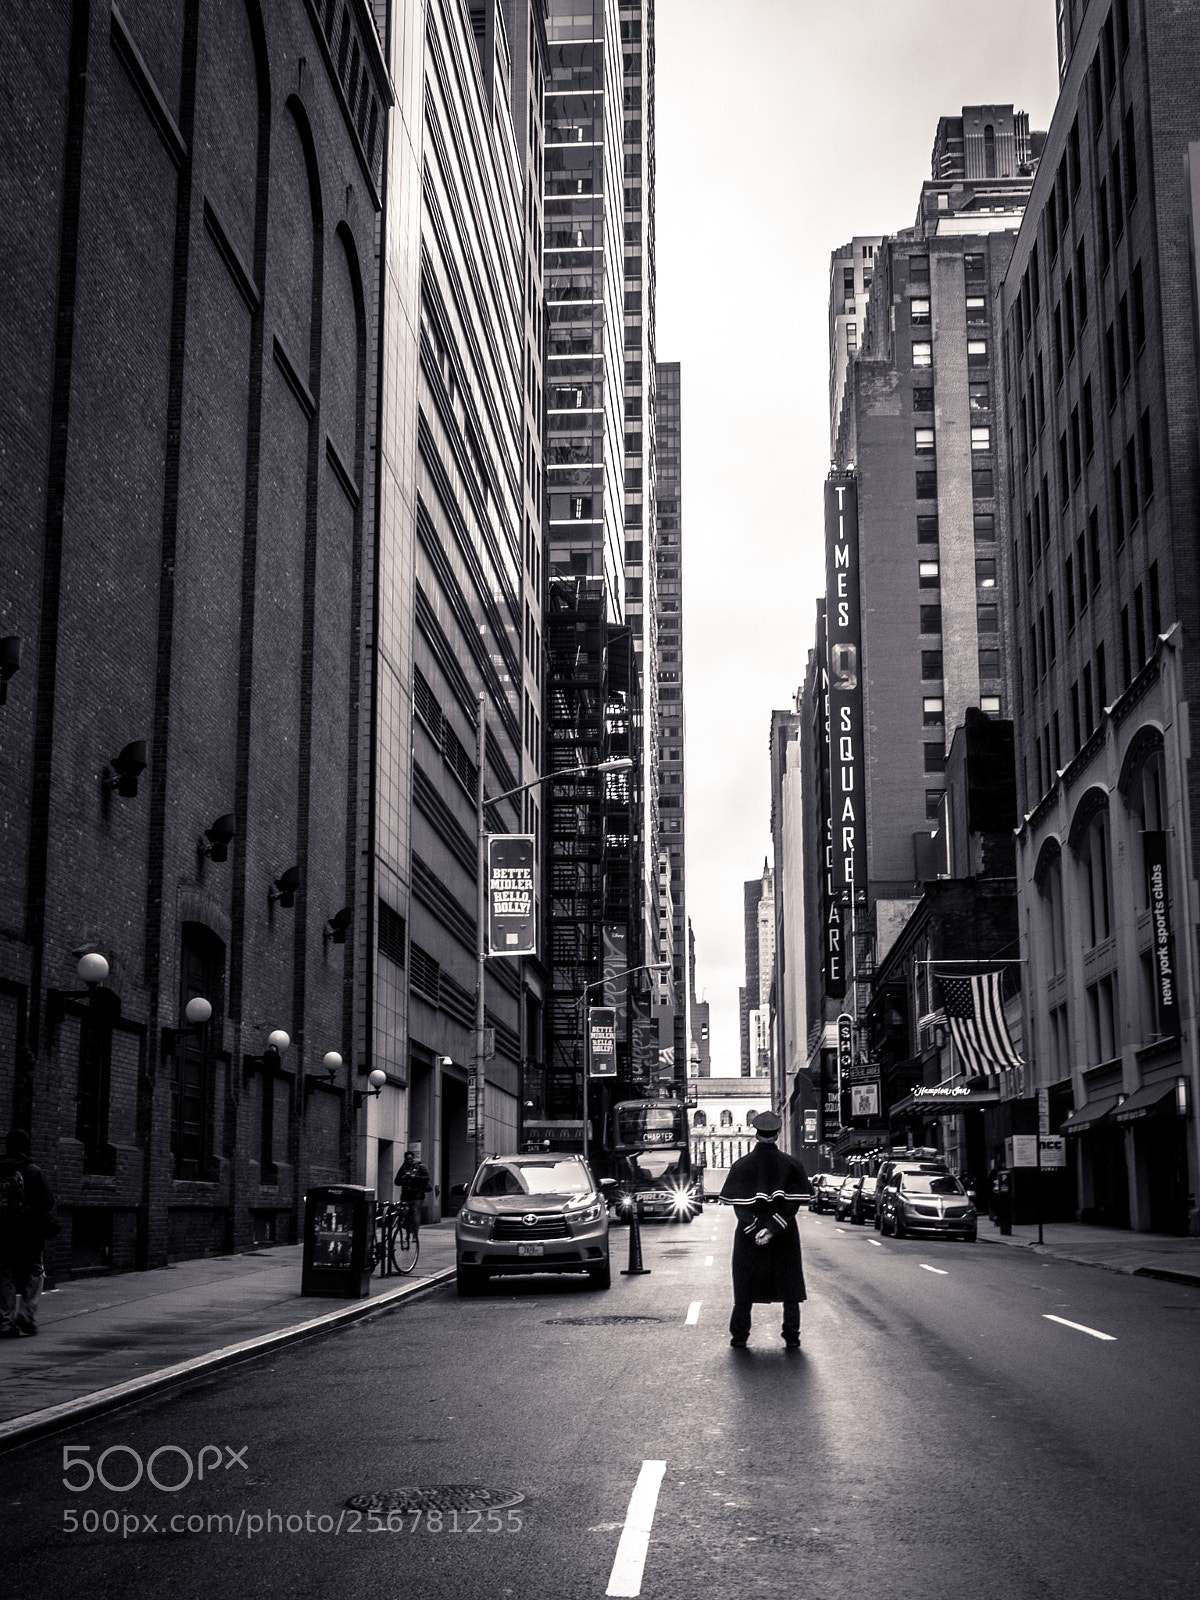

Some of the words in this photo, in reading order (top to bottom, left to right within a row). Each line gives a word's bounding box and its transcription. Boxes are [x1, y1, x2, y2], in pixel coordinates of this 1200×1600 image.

[834, 486, 850, 627] TIMES
[839, 705, 856, 883] SQUARE
[492, 868, 531, 879] BETTE
[1151, 863, 1164, 900] clubs
[490, 879, 534, 890] MIDLER
[493, 891, 532, 903] HELLO,
[493, 902, 532, 914] DOLLY!
[1153, 901, 1168, 944] sports
[1156, 945, 1172, 975] york
[1161, 977, 1172, 1006] new
[913, 1084, 951, 1097] Hampton
[951, 1085, 971, 1097] Inn
[643, 1131, 674, 1143] CHARTER
